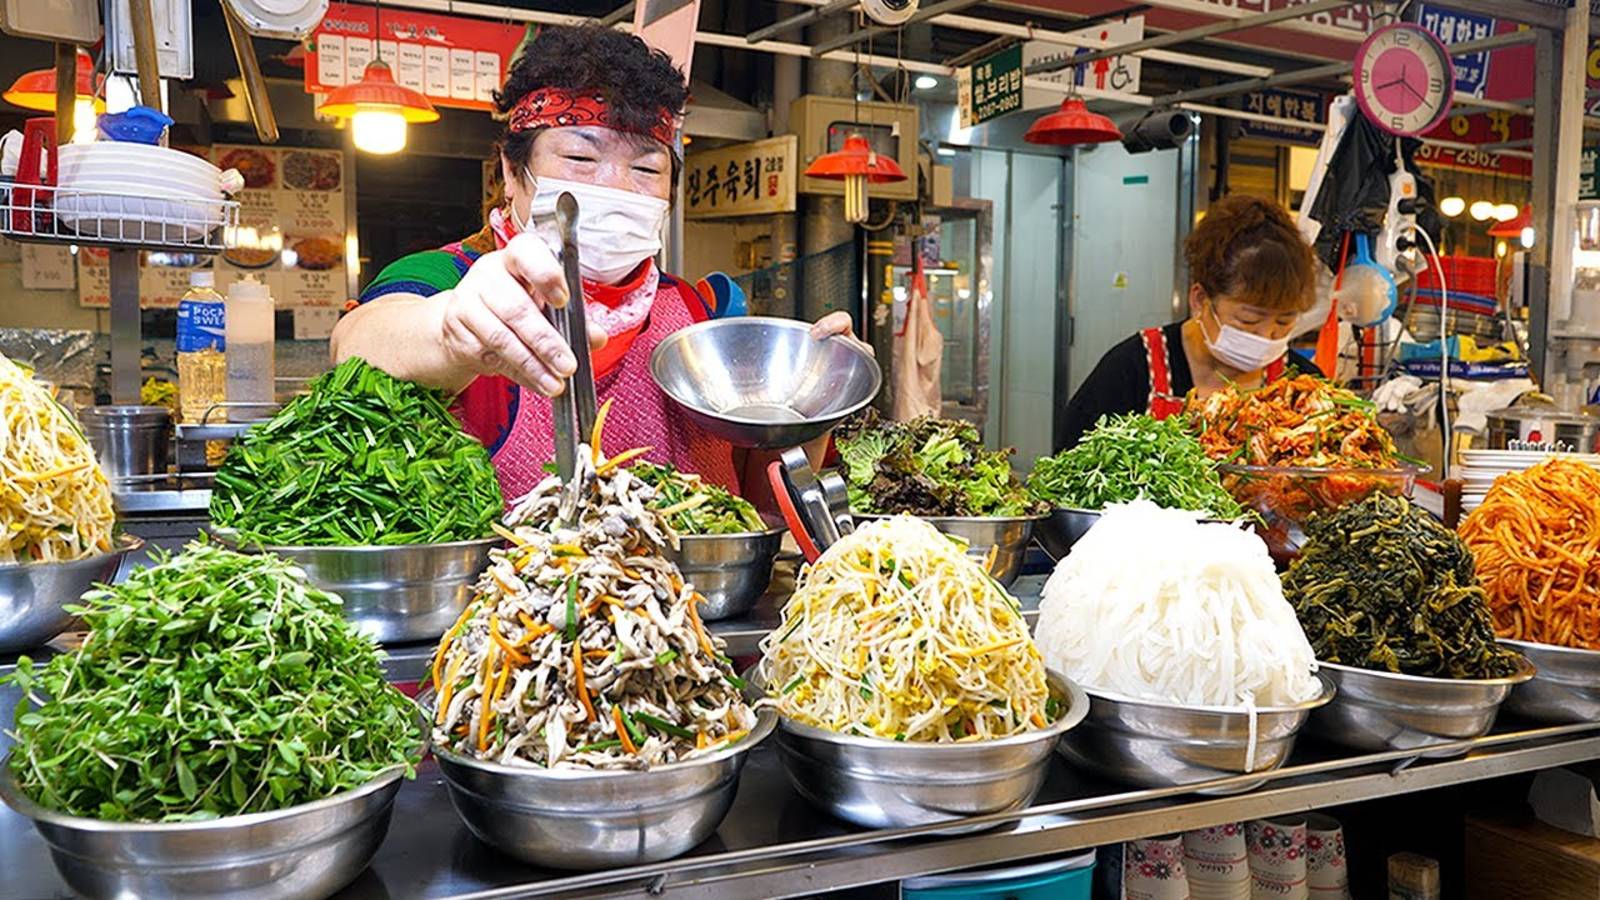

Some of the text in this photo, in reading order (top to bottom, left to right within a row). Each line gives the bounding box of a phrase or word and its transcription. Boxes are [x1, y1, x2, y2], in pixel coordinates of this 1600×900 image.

[1393, 33, 1410, 46] 12
[1391, 117, 1404, 130] 6
[1414, 144, 1501, 168] 67-2962
